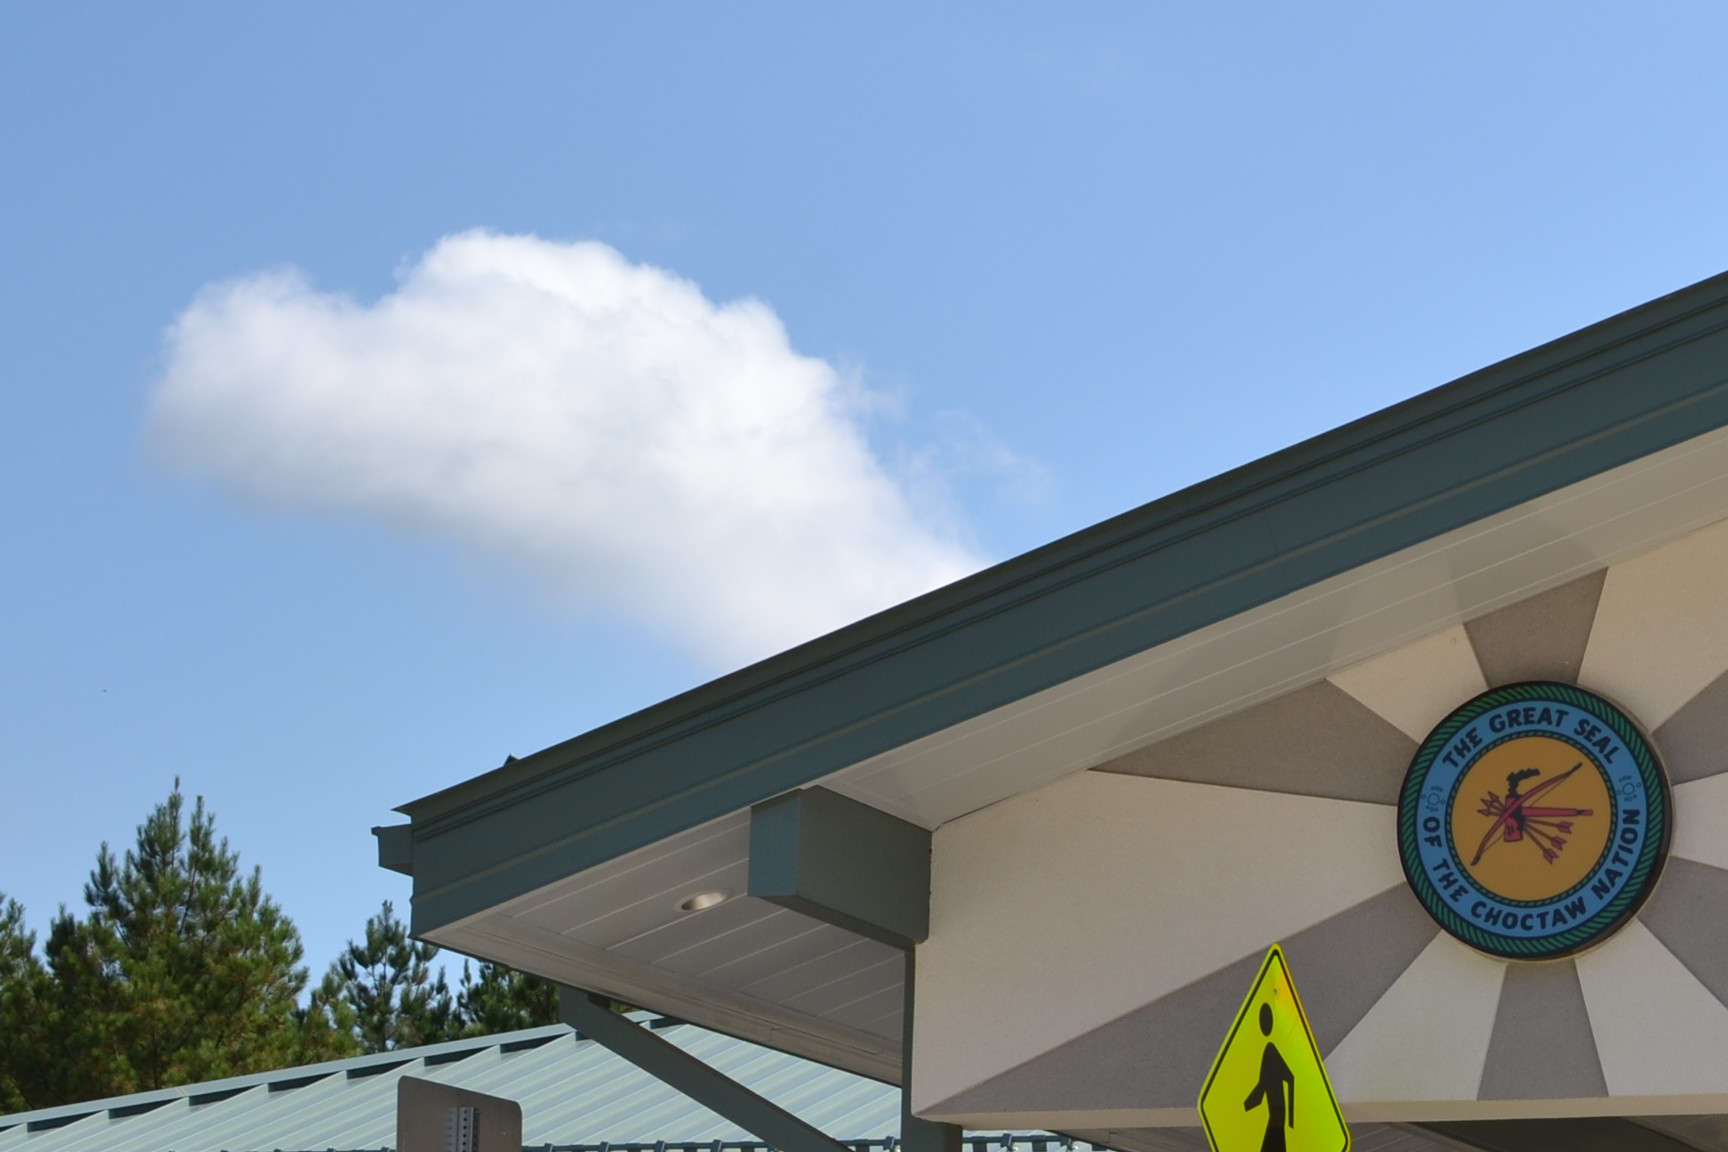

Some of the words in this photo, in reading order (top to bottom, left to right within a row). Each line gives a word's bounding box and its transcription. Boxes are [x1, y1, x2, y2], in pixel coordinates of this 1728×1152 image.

[1441, 727, 1483, 769] THE
[1488, 707, 1569, 733] GREAT
[1574, 719, 1620, 765] SEAL
[1422, 816, 1442, 848] OF
[1432, 858, 1469, 903] THE
[1470, 896, 1587, 931] CHOCTAW
[1590, 808, 1640, 900] NATION
